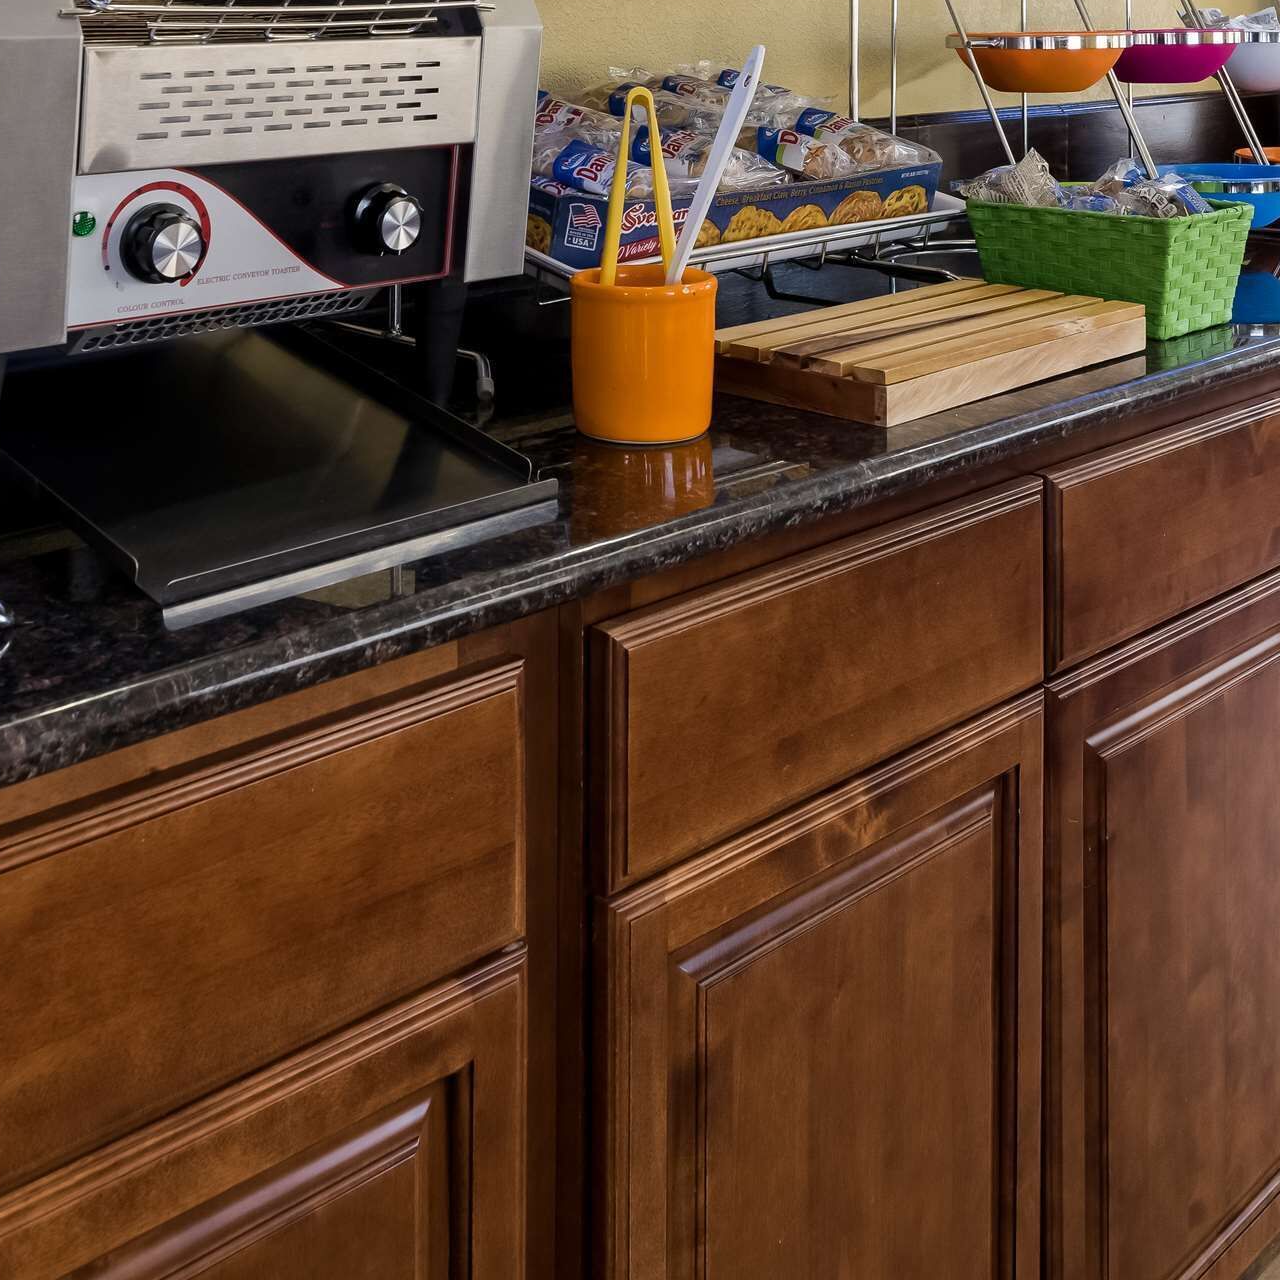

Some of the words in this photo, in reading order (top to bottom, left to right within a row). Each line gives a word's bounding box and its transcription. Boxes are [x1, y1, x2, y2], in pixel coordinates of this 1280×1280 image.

[573, 237, 589, 247] USA
[626, 239, 658, 257] Variety
[196, 273, 231, 285] ELECTRIC
[271, 265, 302, 276] TOASTER
[116, 303, 148, 313] COLOUR
[150, 298, 185, 308] CONTROL
